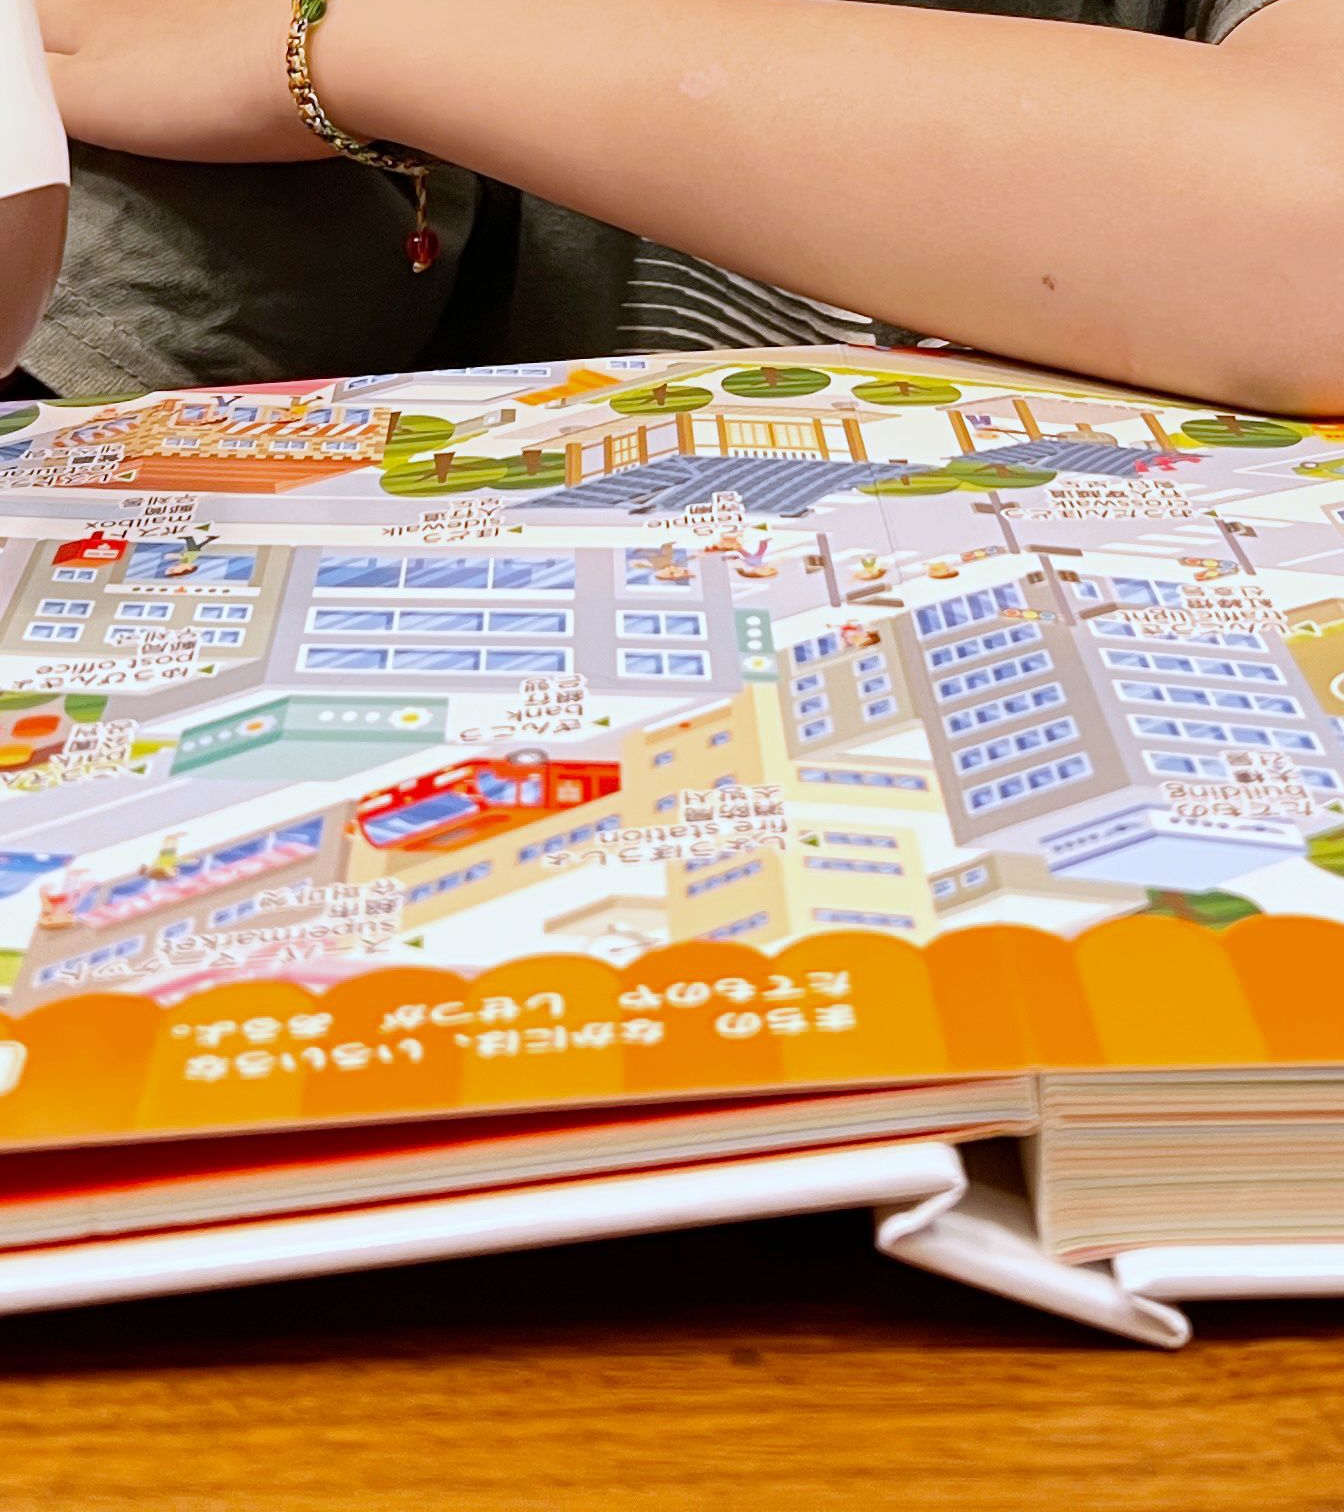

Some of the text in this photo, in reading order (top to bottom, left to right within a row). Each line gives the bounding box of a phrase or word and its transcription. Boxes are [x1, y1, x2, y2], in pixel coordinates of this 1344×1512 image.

[1050, 499, 1189, 508] crosswalk
[84, 515, 192, 530] mailbox
[382, 518, 503, 537] sidewalk
[647, 514, 743, 529] temple
[110, 525, 188, 539] ポスト
[423, 528, 500, 544] ほどう
[1120, 609, 1284, 622] traffic light
[36, 652, 195, 676] post office
[505, 704, 583, 722] bank
[459, 719, 582, 742] ぎんこう
[53, 751, 126, 769] park
[683, 785, 781, 805] 소방서
[1165, 783, 1308, 800] building
[684, 802, 785, 822] 消防局
[1176, 801, 1313, 817] たてもの
[598, 818, 788, 844] fire station
[544, 836, 787, 866] しょうぼうしょ
[161, 920, 397, 955] supermarket
[169, 970, 852, 1045] たてものや しせつが あるよ。
[183, 1004, 855, 1082] まちの なかには、 いろいろな
